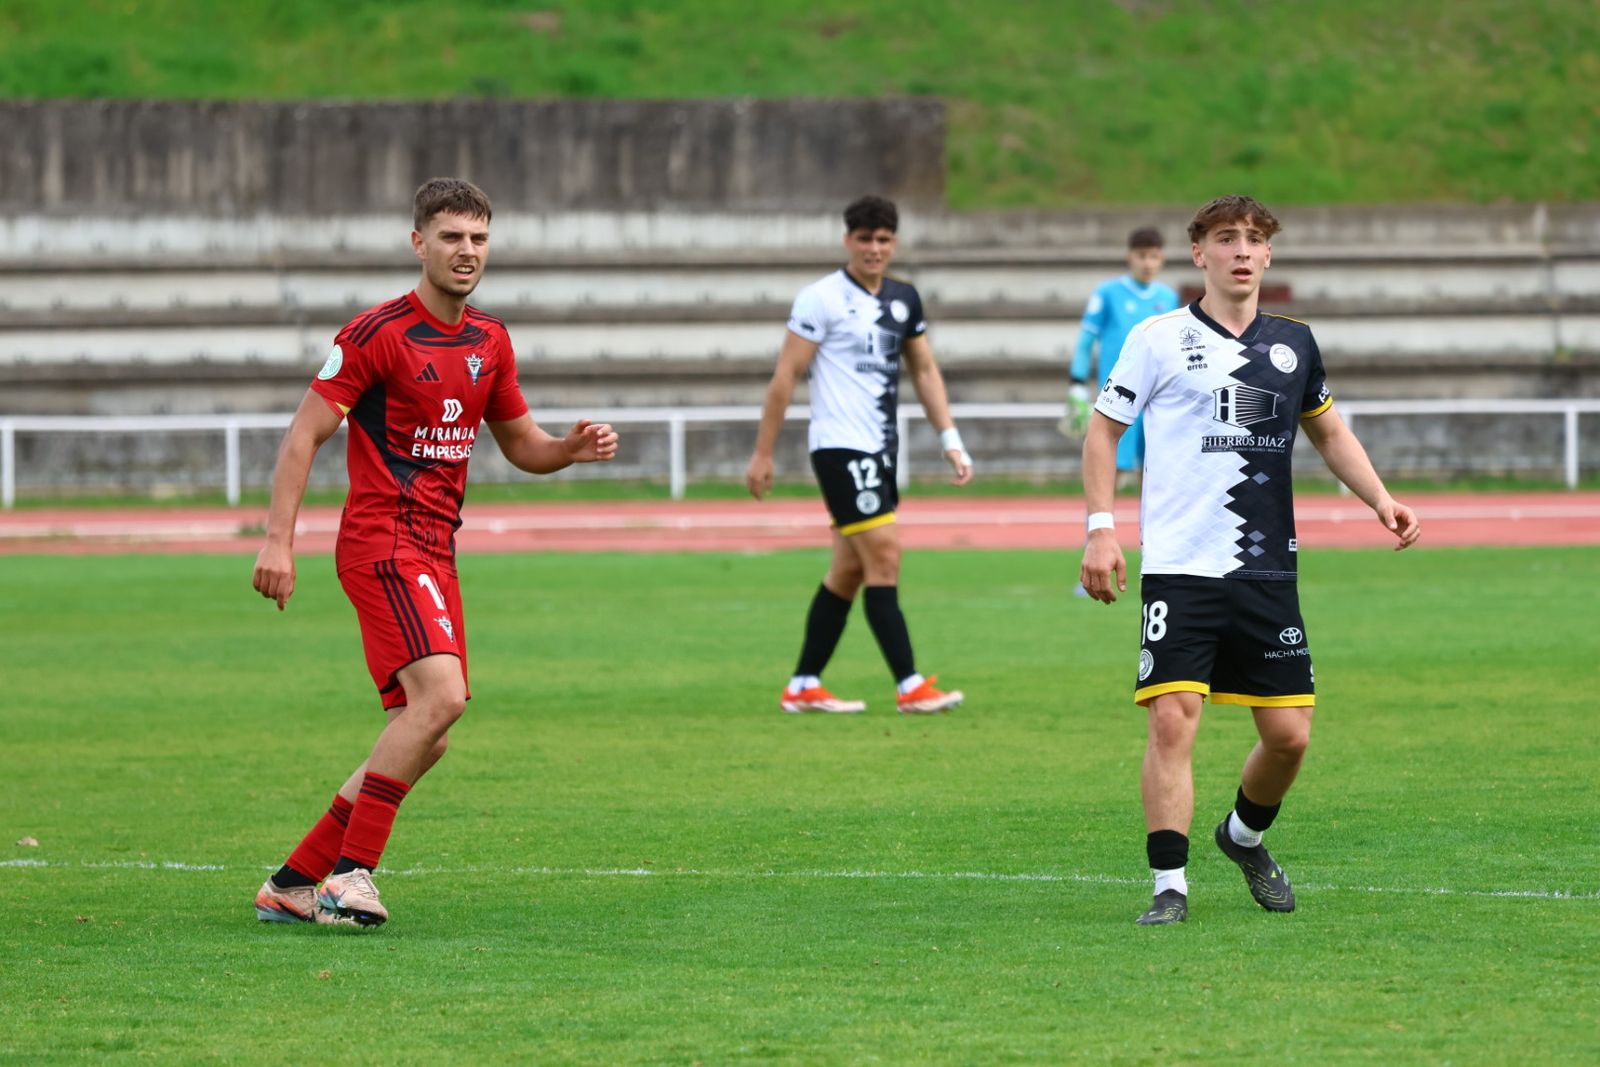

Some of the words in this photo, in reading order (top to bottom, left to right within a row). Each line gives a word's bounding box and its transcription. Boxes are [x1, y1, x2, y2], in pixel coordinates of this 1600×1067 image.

[414, 426, 475, 441] MIRANDA
[1202, 435, 1255, 448] HIERROS
[1257, 434, 1286, 448] DÍAZ
[411, 443, 473, 459] EMPRESAS
[847, 457, 882, 490] 12
[1142, 600, 1168, 645] 18
[1264, 650, 1296, 659] HACHA
